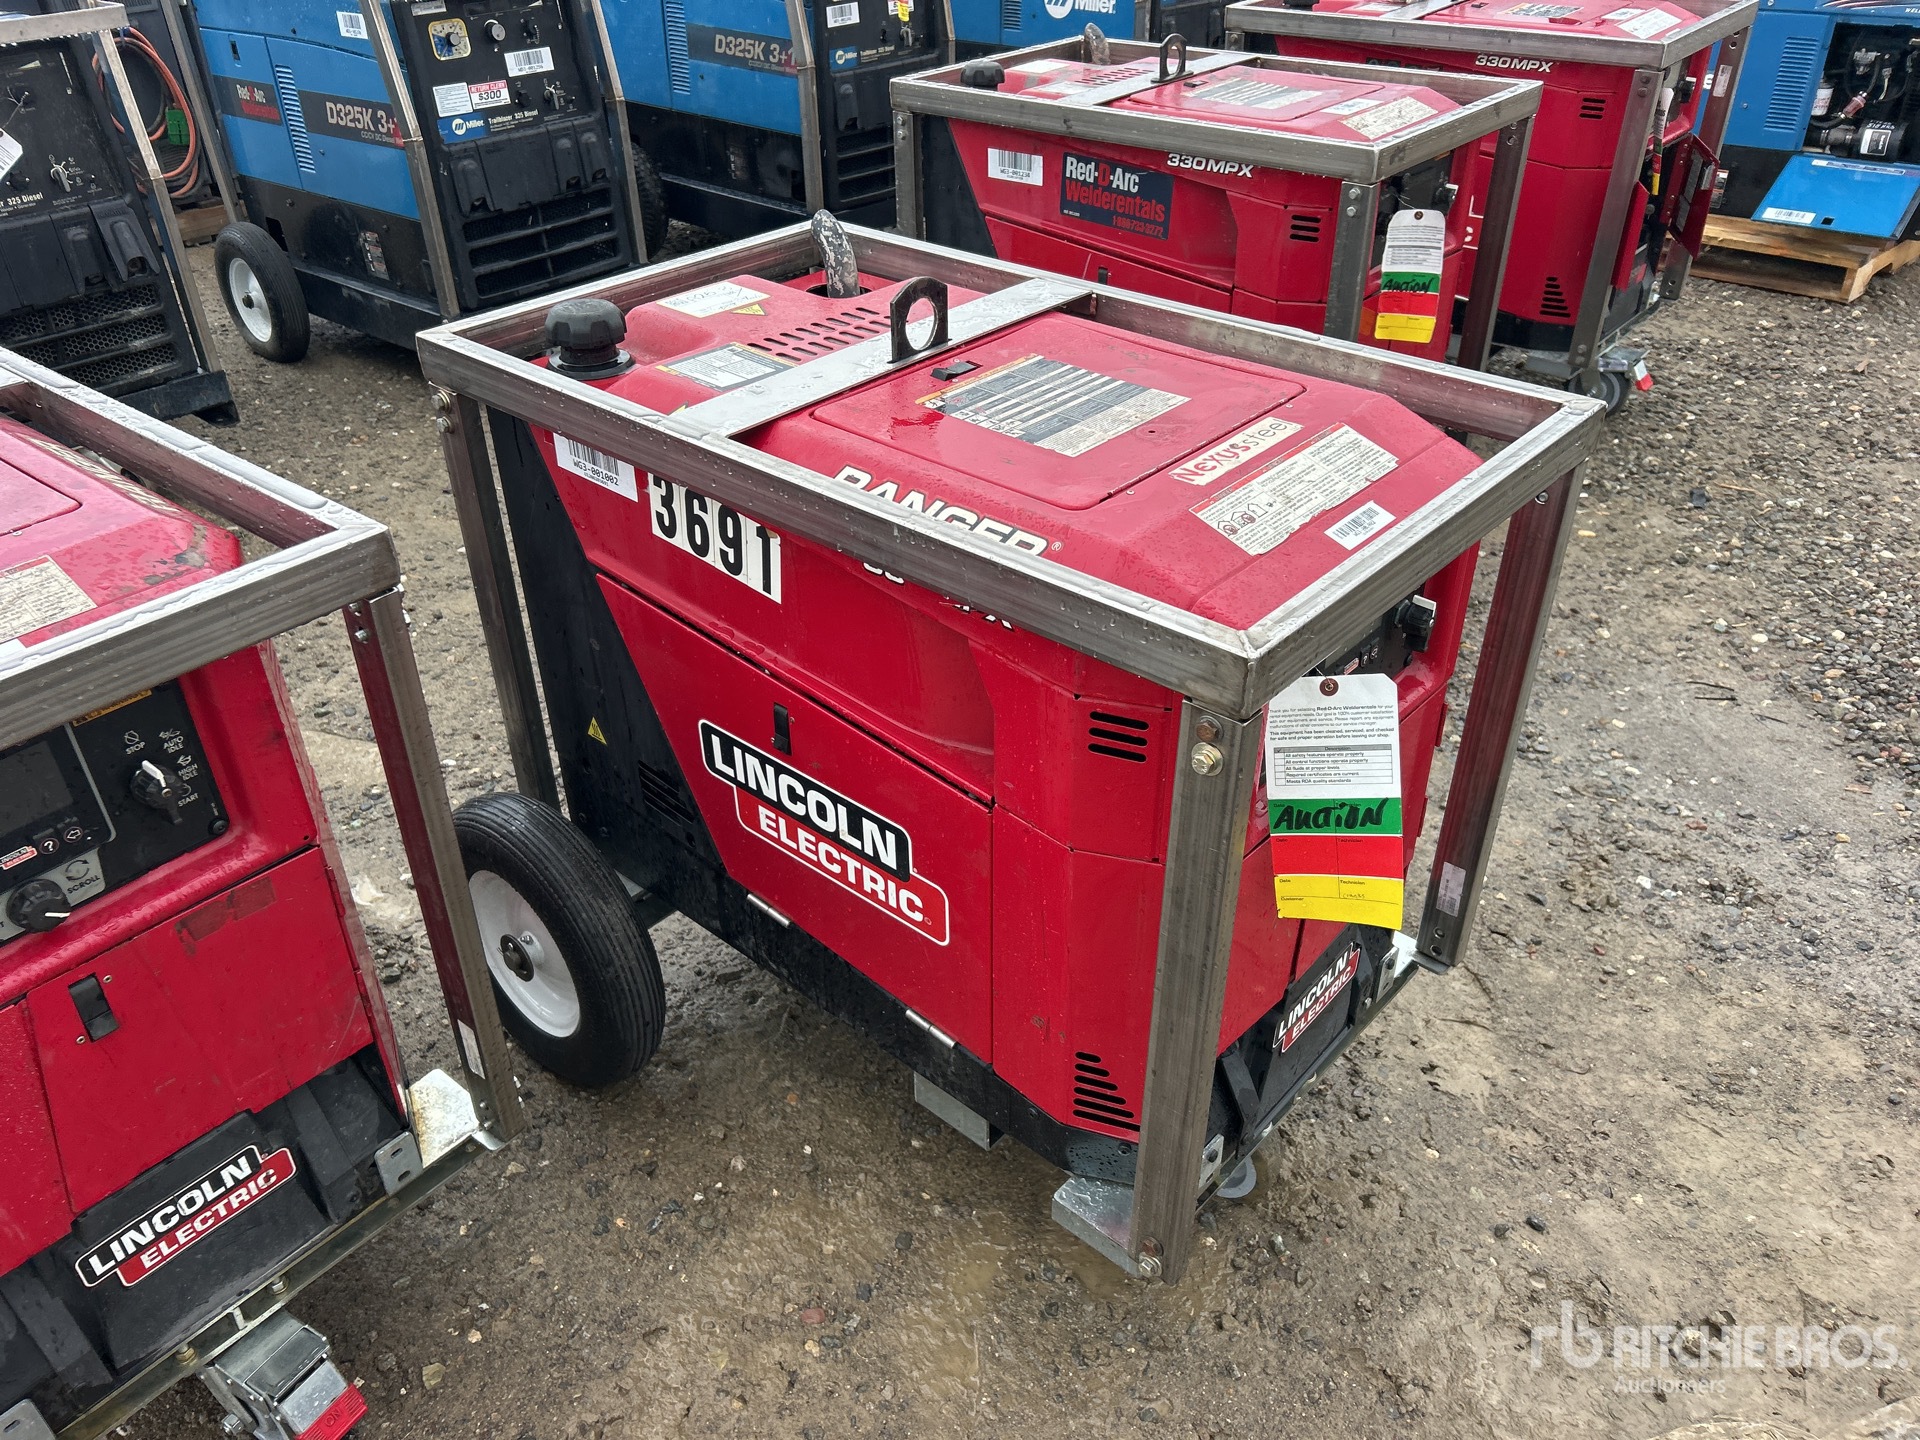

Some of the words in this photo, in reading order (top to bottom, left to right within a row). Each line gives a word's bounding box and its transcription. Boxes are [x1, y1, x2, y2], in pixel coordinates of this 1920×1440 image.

[715, 34, 766, 61] D325K
[1475, 55, 1552, 73] 330MPX
[478, 90, 502, 101] $300
[325, 101, 375, 131] D325K
[377, 109, 398, 134] 3+
[466, 120, 485, 129] Miller
[1066, 156, 1140, 193] Red-D-Arc
[1167, 153, 1254, 178] 330MPX
[7, 196, 21, 206] 325
[21, 192, 44, 203] Diesel
[1065, 180, 1166, 223] Welderentals
[573, 458, 620, 486] WG3-001002
[653, 474, 772, 596] 3691
[126, 741, 146, 755] STOP
[163, 736, 184, 749] AUTO
[168, 743, 184, 754] IDLE
[178, 763, 198, 777] HIGH
[182, 771, 198, 781] IDLE
[178, 792, 199, 807] START
[711, 733, 897, 870] LINCOLN
[758, 805, 924, 922] ELECTRIC
[67, 875, 100, 894] SCROLL
[1278, 951, 1348, 1039] LINCOLN
[1292, 966, 1351, 1039] ELECTRIC
[89, 1156, 252, 1276] LINCOLN
[140, 1168, 277, 1269] ELECTRIC
